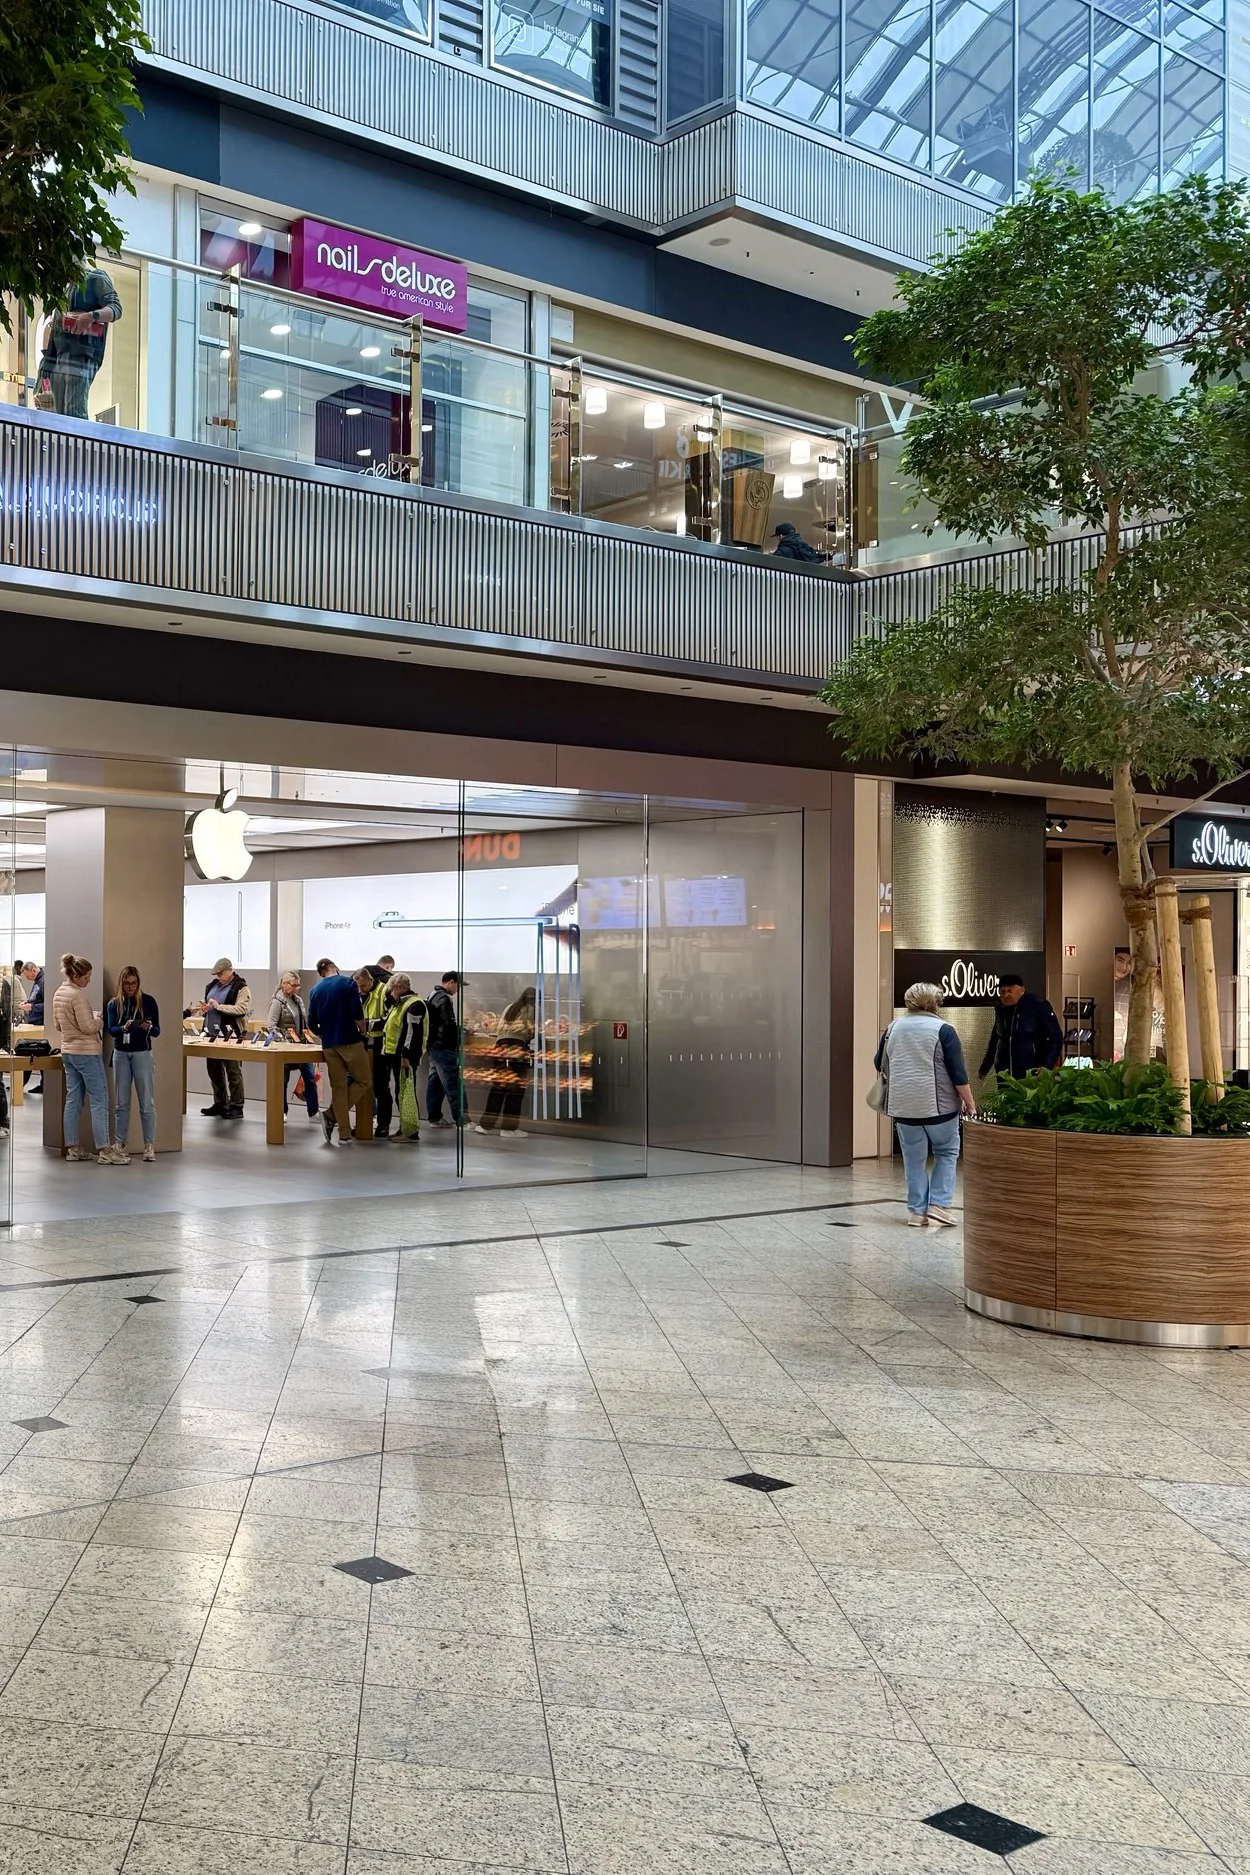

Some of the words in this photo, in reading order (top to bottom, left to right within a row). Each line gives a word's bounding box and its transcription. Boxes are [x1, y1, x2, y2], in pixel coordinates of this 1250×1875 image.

[592, 3, 605, 15] SIE
[543, 20, 582, 43] Instagram
[317, 243, 456, 300] nailsdeluxe
[381, 285, 397, 298] true
[398, 291, 434, 308] american
[434, 301, 454, 314] style
